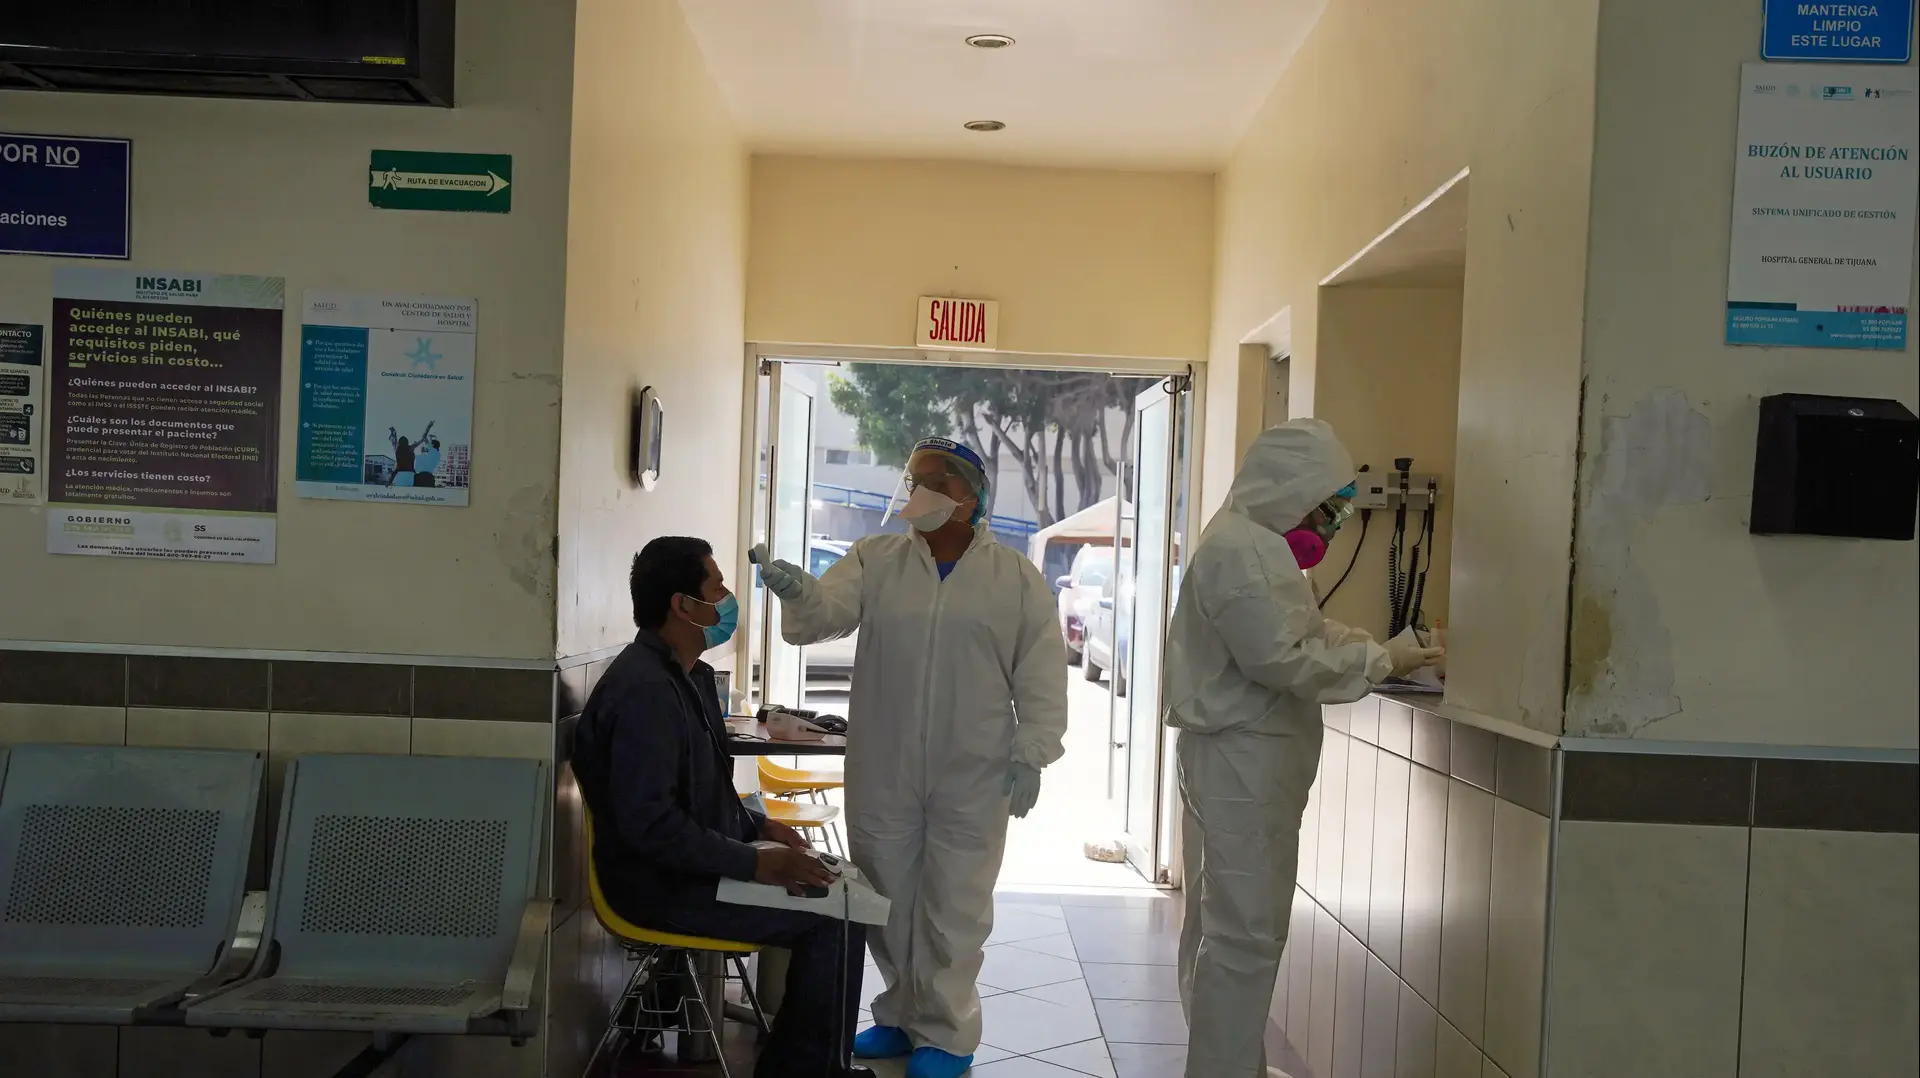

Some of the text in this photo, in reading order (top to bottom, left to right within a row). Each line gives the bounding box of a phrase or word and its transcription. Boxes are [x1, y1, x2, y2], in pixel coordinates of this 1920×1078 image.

[1797, 4, 1878, 17] MANTENGA
[1813, 20, 1861, 32] LIMPIO
[1791, 34, 1881, 48] ESTE LUGAR
[0, 143, 80, 166] OR NO
[1748, 142, 1908, 161] BUZÓN DE ATENCIÓN
[1780, 165, 1872, 180] AL USUARIO
[407, 177, 427, 185] RUTA
[440, 179, 487, 187] EVACUACION
[1752, 207, 1896, 219] SISTEMA UNIFICADO DE GESTIÓN
[1761, 255, 1877, 267] HOSPITAL GENERAL DE TIJUANA
[136, 276, 202, 292] INSABI
[412, 302, 455, 311] CIUDADANO
[70, 308, 193, 324] Quiénes pueden
[401, 310, 430, 318] CENTRO
[437, 319, 471, 327] HOSPITAL
[929, 299, 986, 343] SALIDA
[69, 324, 241, 342] acceder al INSABI, qué
[69, 337, 198, 355] requisitos piden,
[69, 351, 223, 368] servicios sin costo...
[68, 377, 257, 394] ¿Quiénes pueden acceder al INSABI?
[156, 395, 178, 403] tienen
[209, 399, 243, 407] seguridad
[150, 404, 176, 412] pueden
[200, 406, 230, 414] atención
[67, 415, 107, 424] ¿Cuáles
[131, 417, 146, 426] los
[148, 419, 213, 430] documentos
[215, 423, 235, 432] que
[67, 425, 218, 439] puede presentar el paciente?
[66, 445, 102, 453] credencial
[129, 440, 149, 448] Única
[160, 442, 188, 450] Registro
[199, 443, 233, 452] Población
[234, 446, 260, 454] (CURP),
[929, 439, 952, 448] Shield
[65, 468, 211, 483] ¿Los servicios tienen costo?
[105, 485, 132, 493] médica,
[133, 486, 183, 494] medicamentos
[67, 515, 131, 525] GOBIERNO
[194, 524, 206, 532] SS
